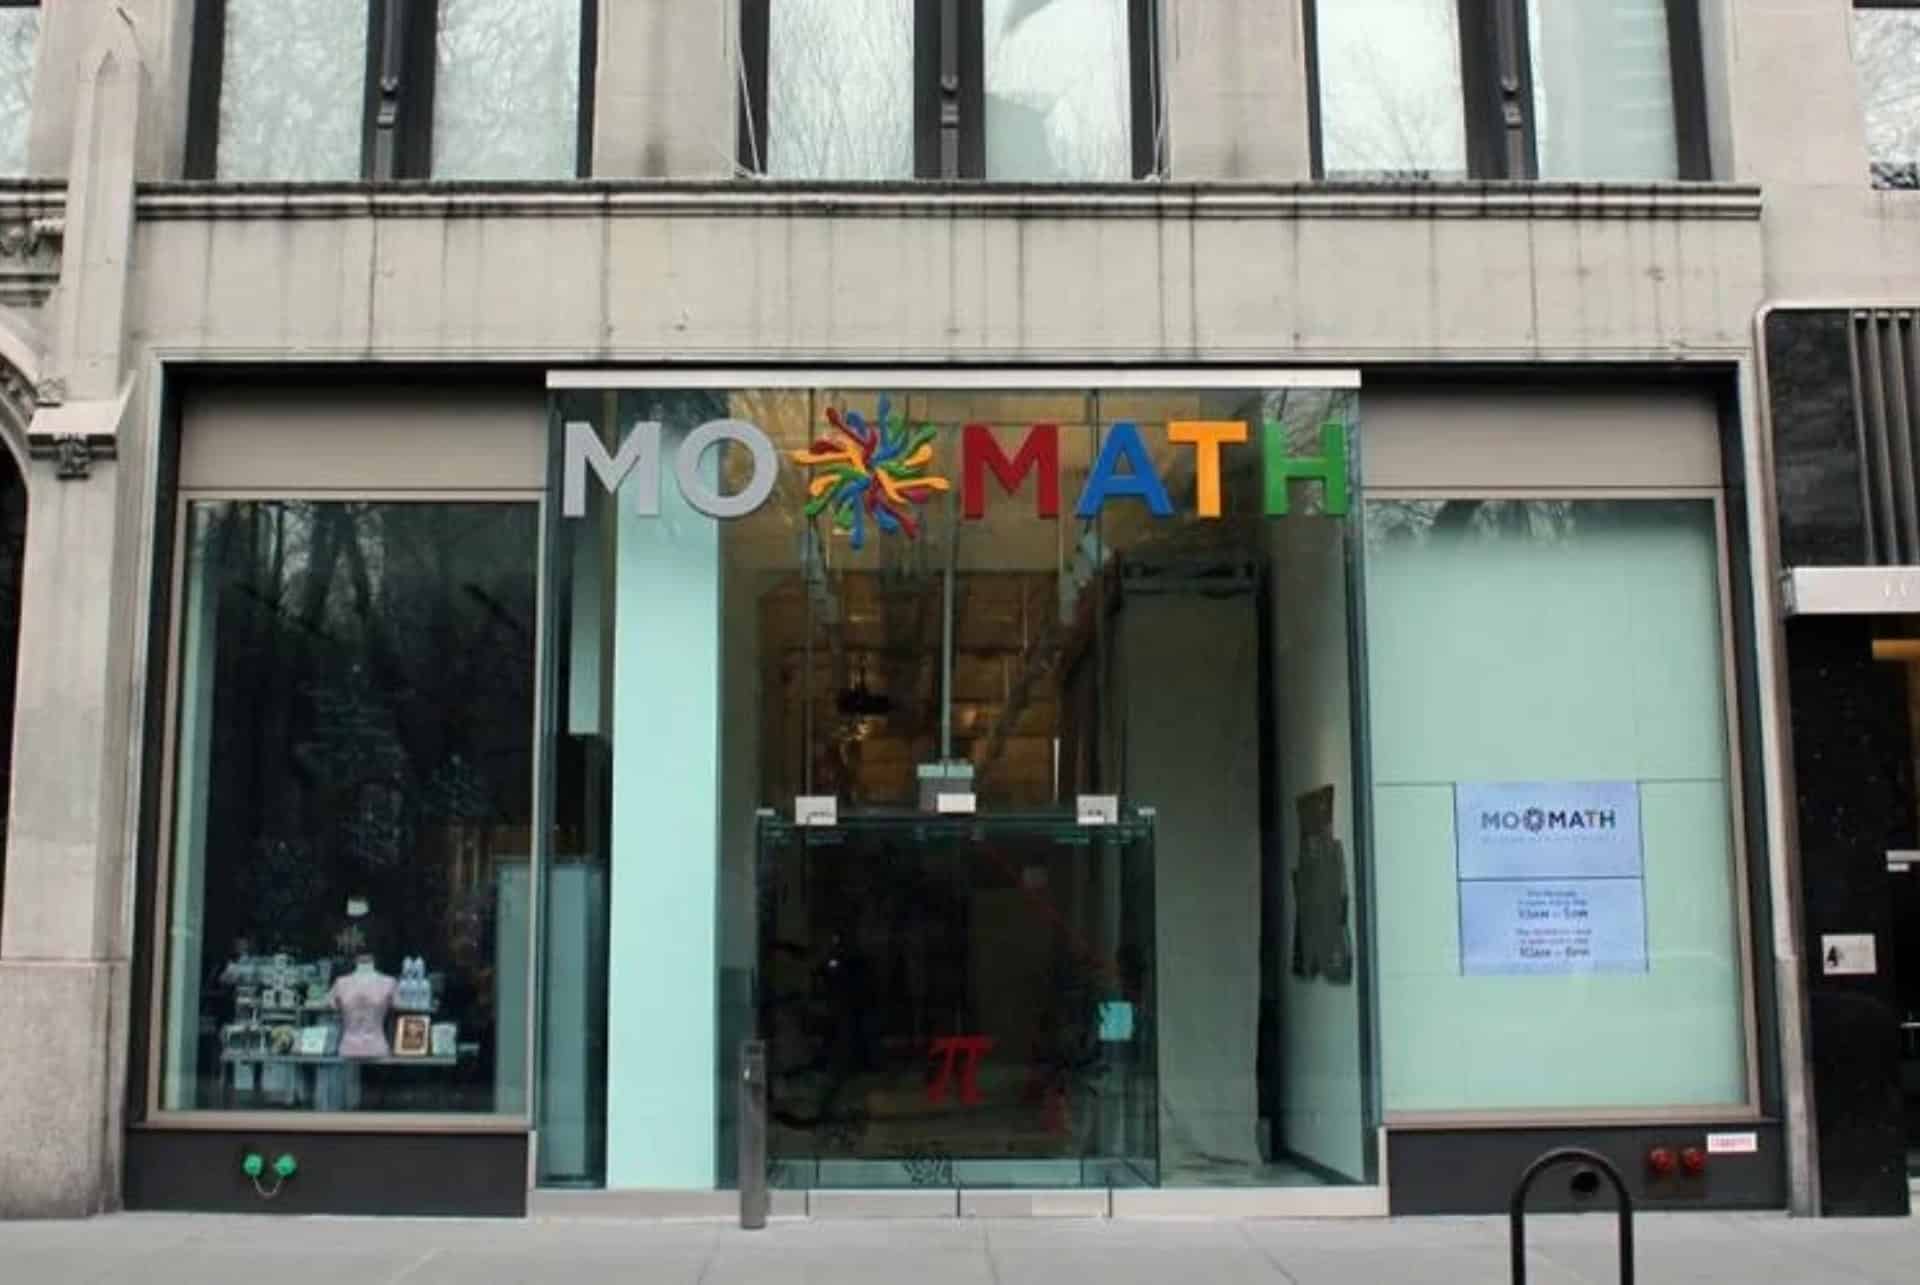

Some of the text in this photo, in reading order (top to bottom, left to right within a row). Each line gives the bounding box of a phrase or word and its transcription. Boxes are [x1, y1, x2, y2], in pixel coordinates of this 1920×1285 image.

[563, 420, 1351, 520] MO MATH
[1481, 810, 1616, 829] MO MATH
